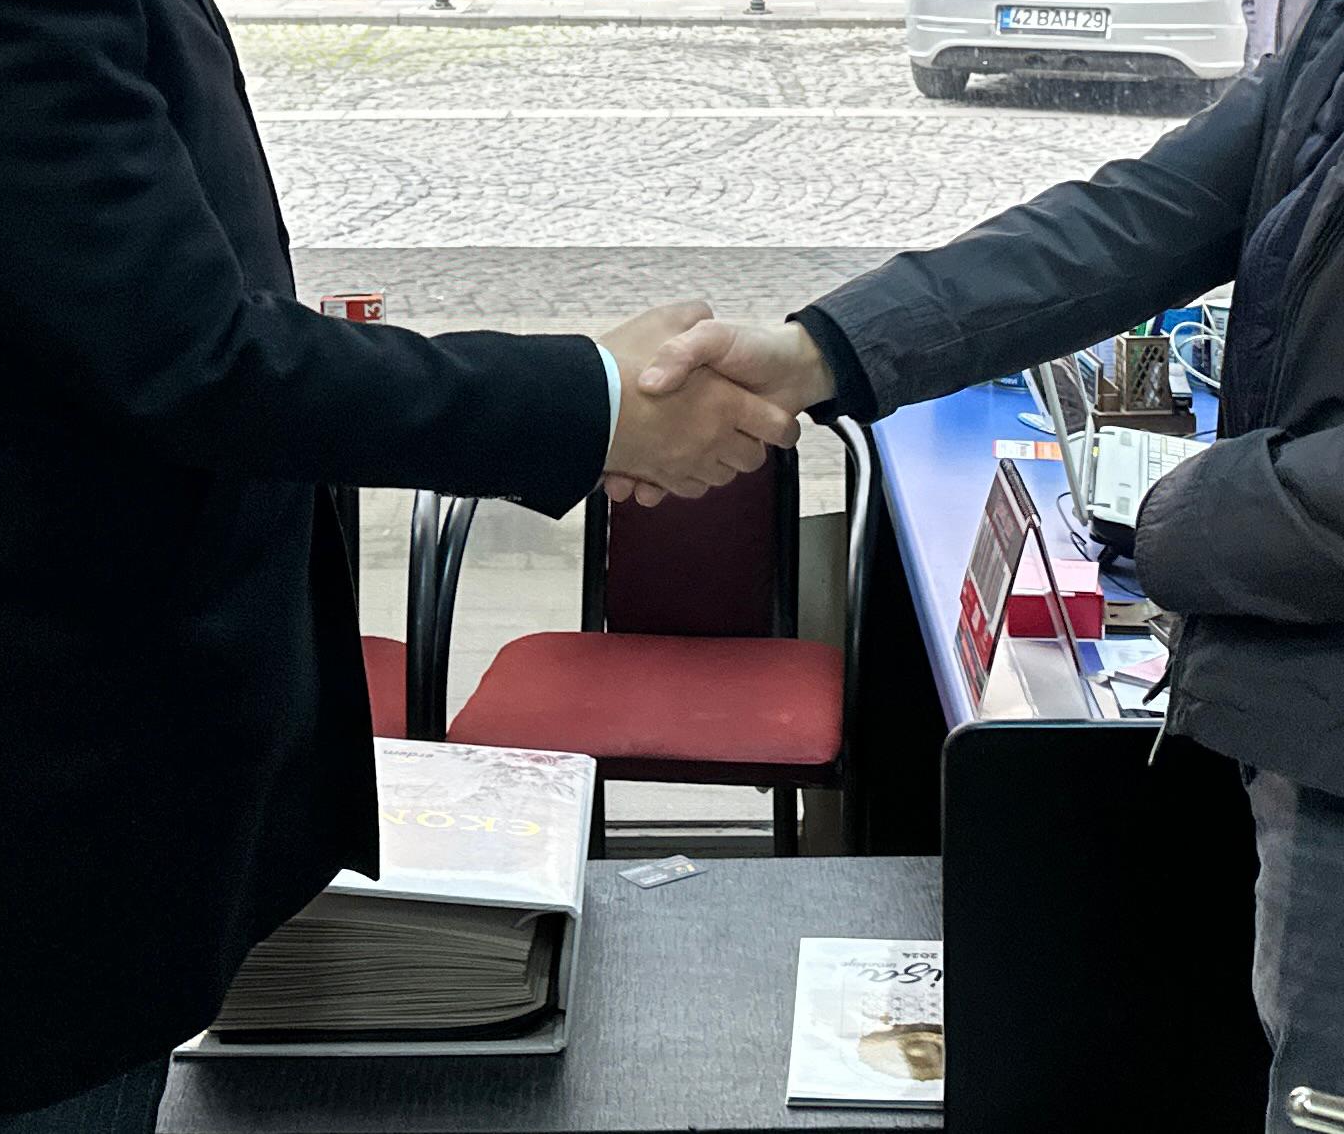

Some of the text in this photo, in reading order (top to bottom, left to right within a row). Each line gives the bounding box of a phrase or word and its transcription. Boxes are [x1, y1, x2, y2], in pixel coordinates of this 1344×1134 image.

[1012, 9, 1103, 28] 42 BAH 29
